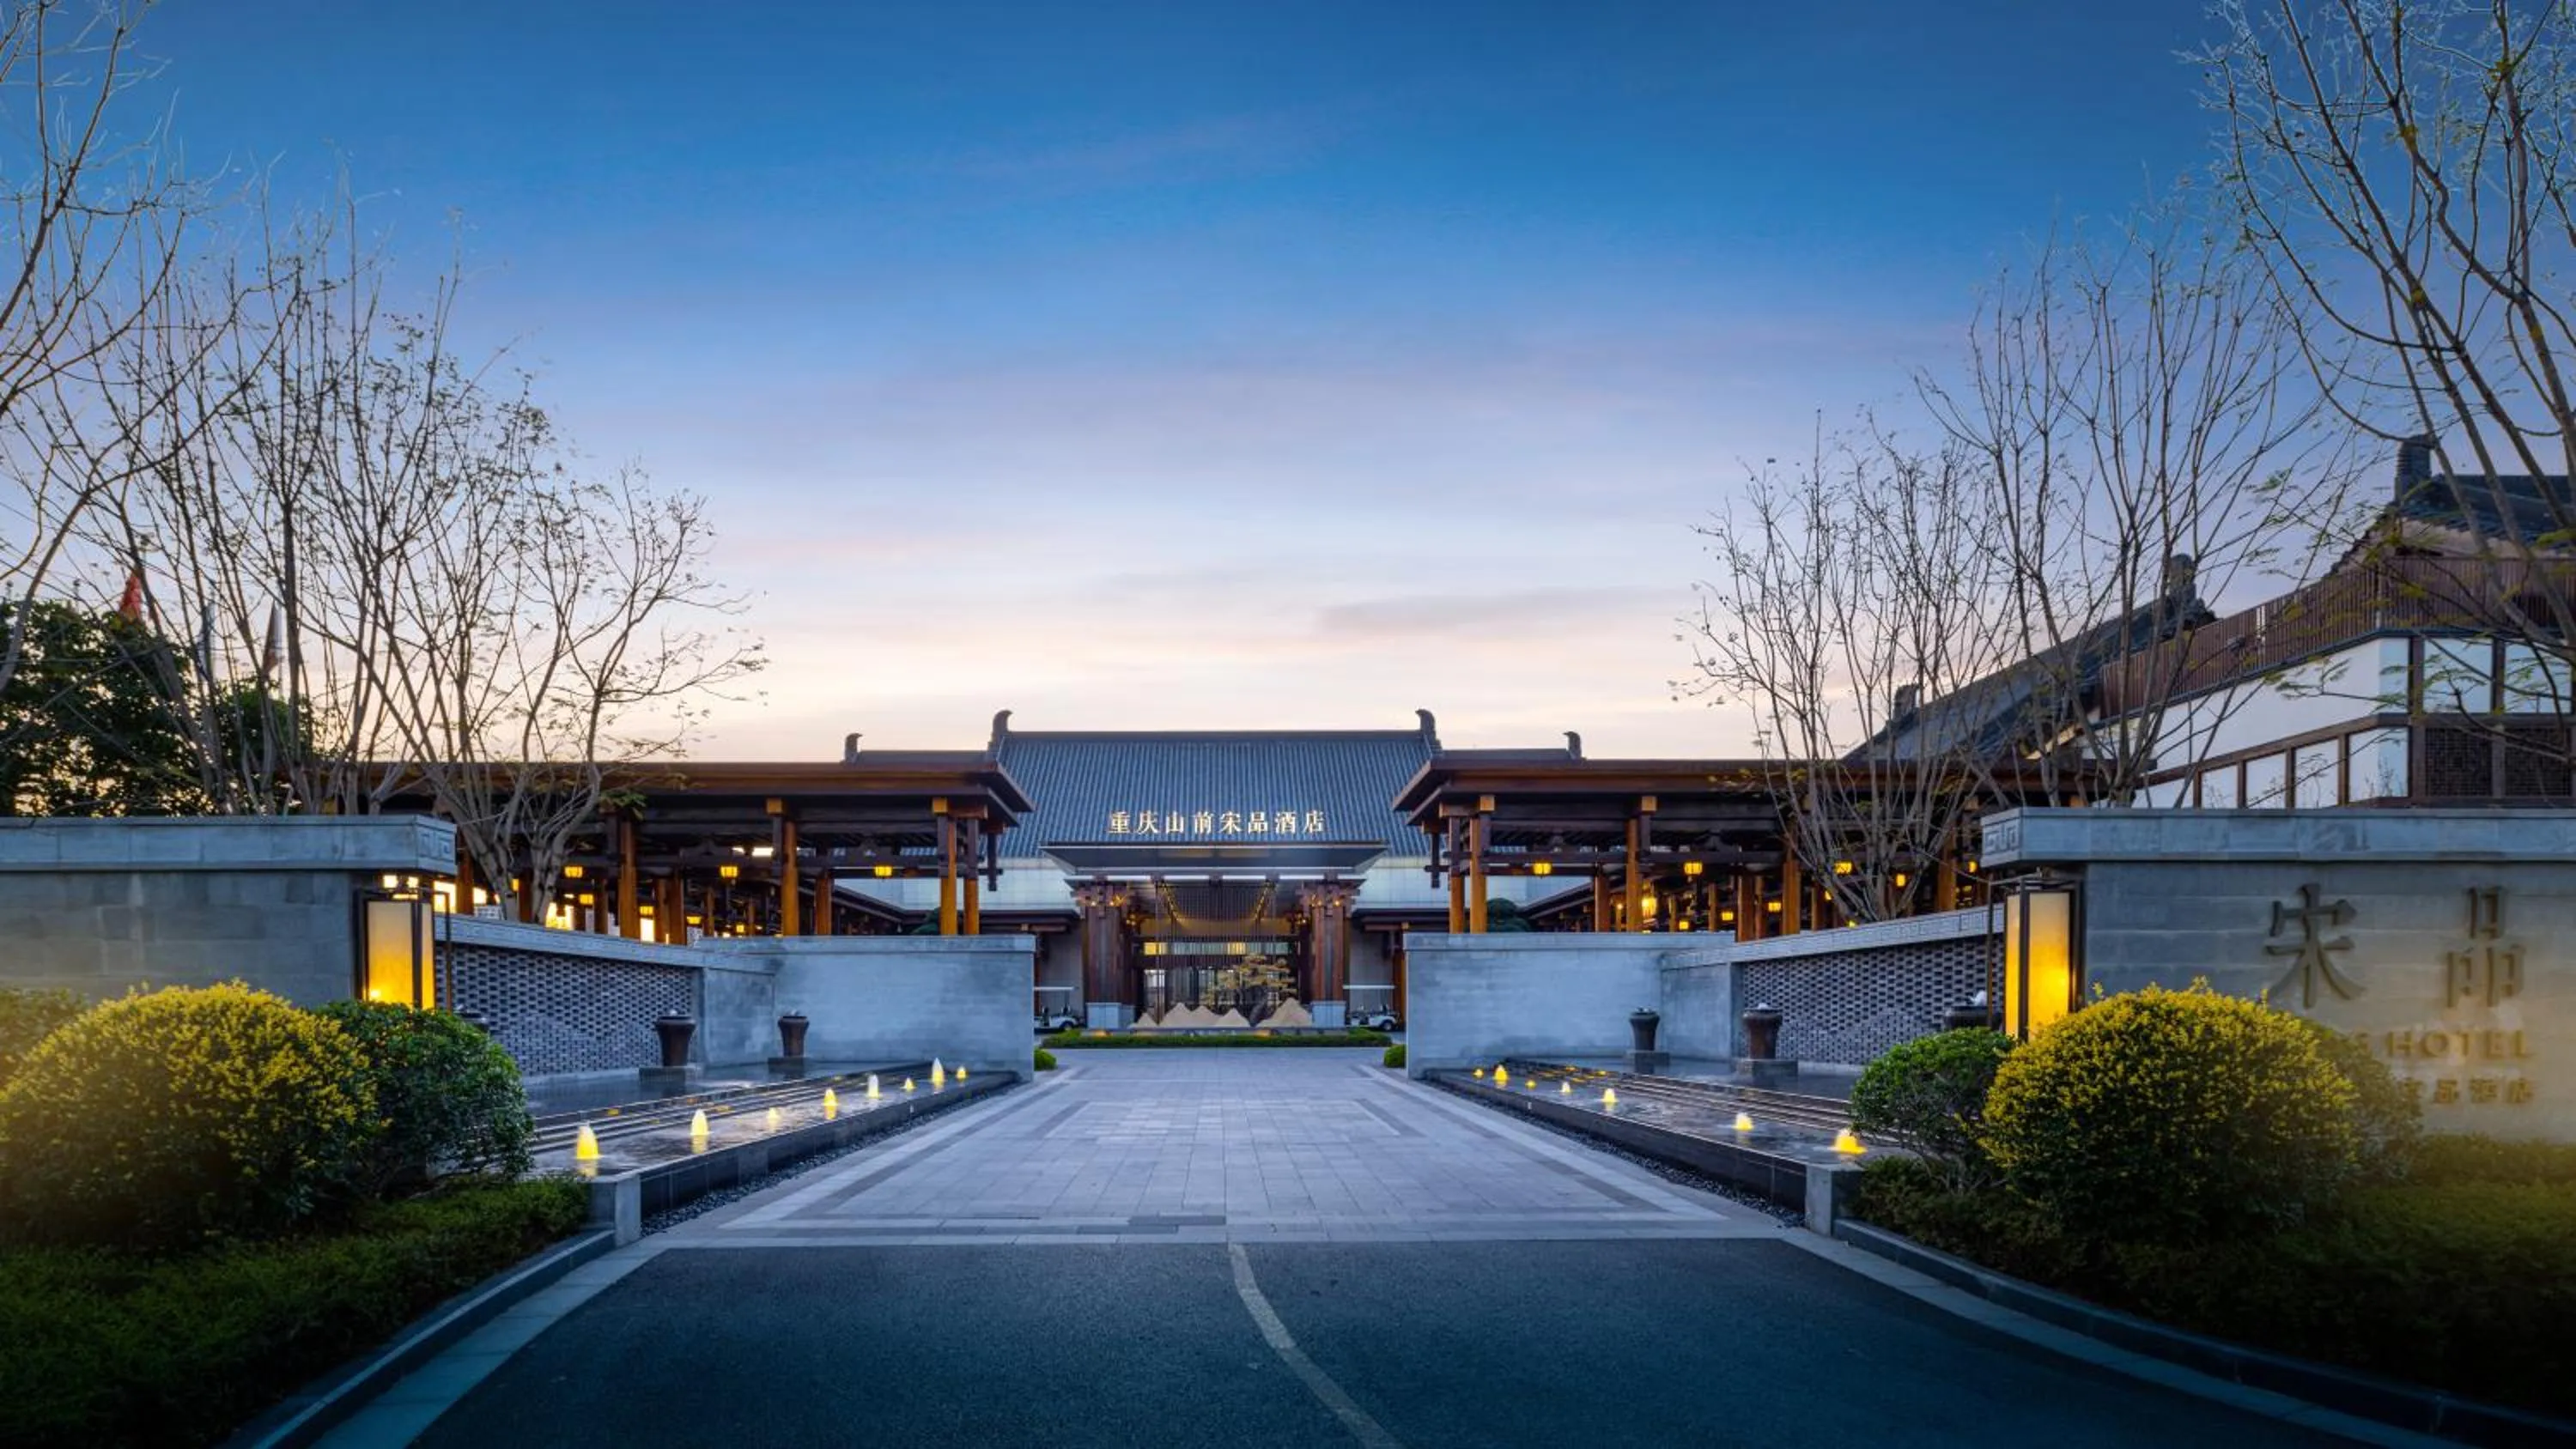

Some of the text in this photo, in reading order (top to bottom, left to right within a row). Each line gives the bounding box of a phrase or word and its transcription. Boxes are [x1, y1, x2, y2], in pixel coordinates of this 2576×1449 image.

[1108, 810, 1327, 835] 重庆山前宋品酒店
[2386, 1030, 2531, 1058] HOTEL
